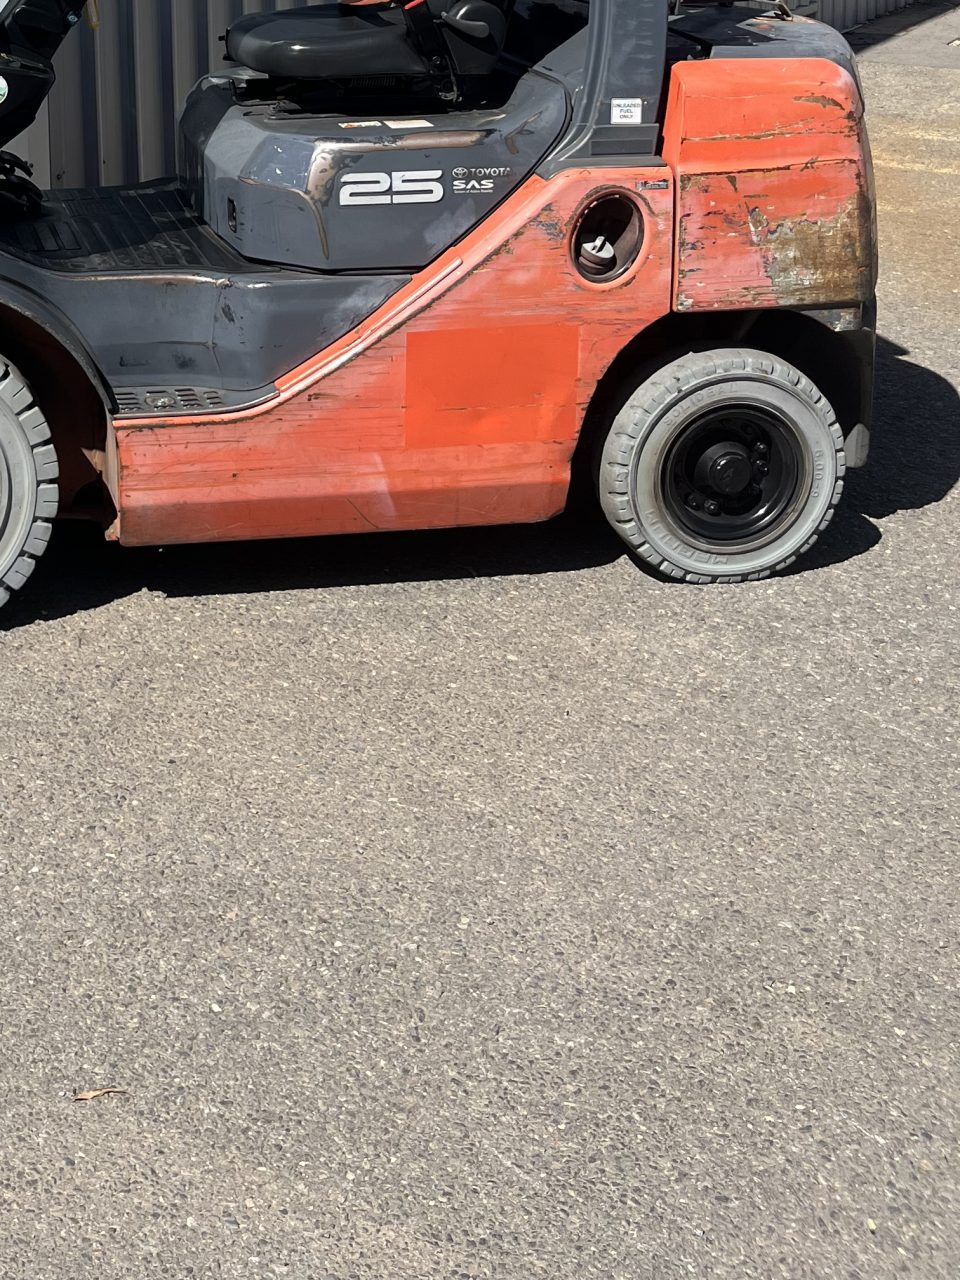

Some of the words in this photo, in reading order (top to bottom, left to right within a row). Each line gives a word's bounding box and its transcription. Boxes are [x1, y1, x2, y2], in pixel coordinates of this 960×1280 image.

[469, 167, 512, 177] TOYOTA
[339, 170, 444, 206] 25
[452, 179, 494, 190] SAS
[663, 383, 739, 427] SOLIDEAL
